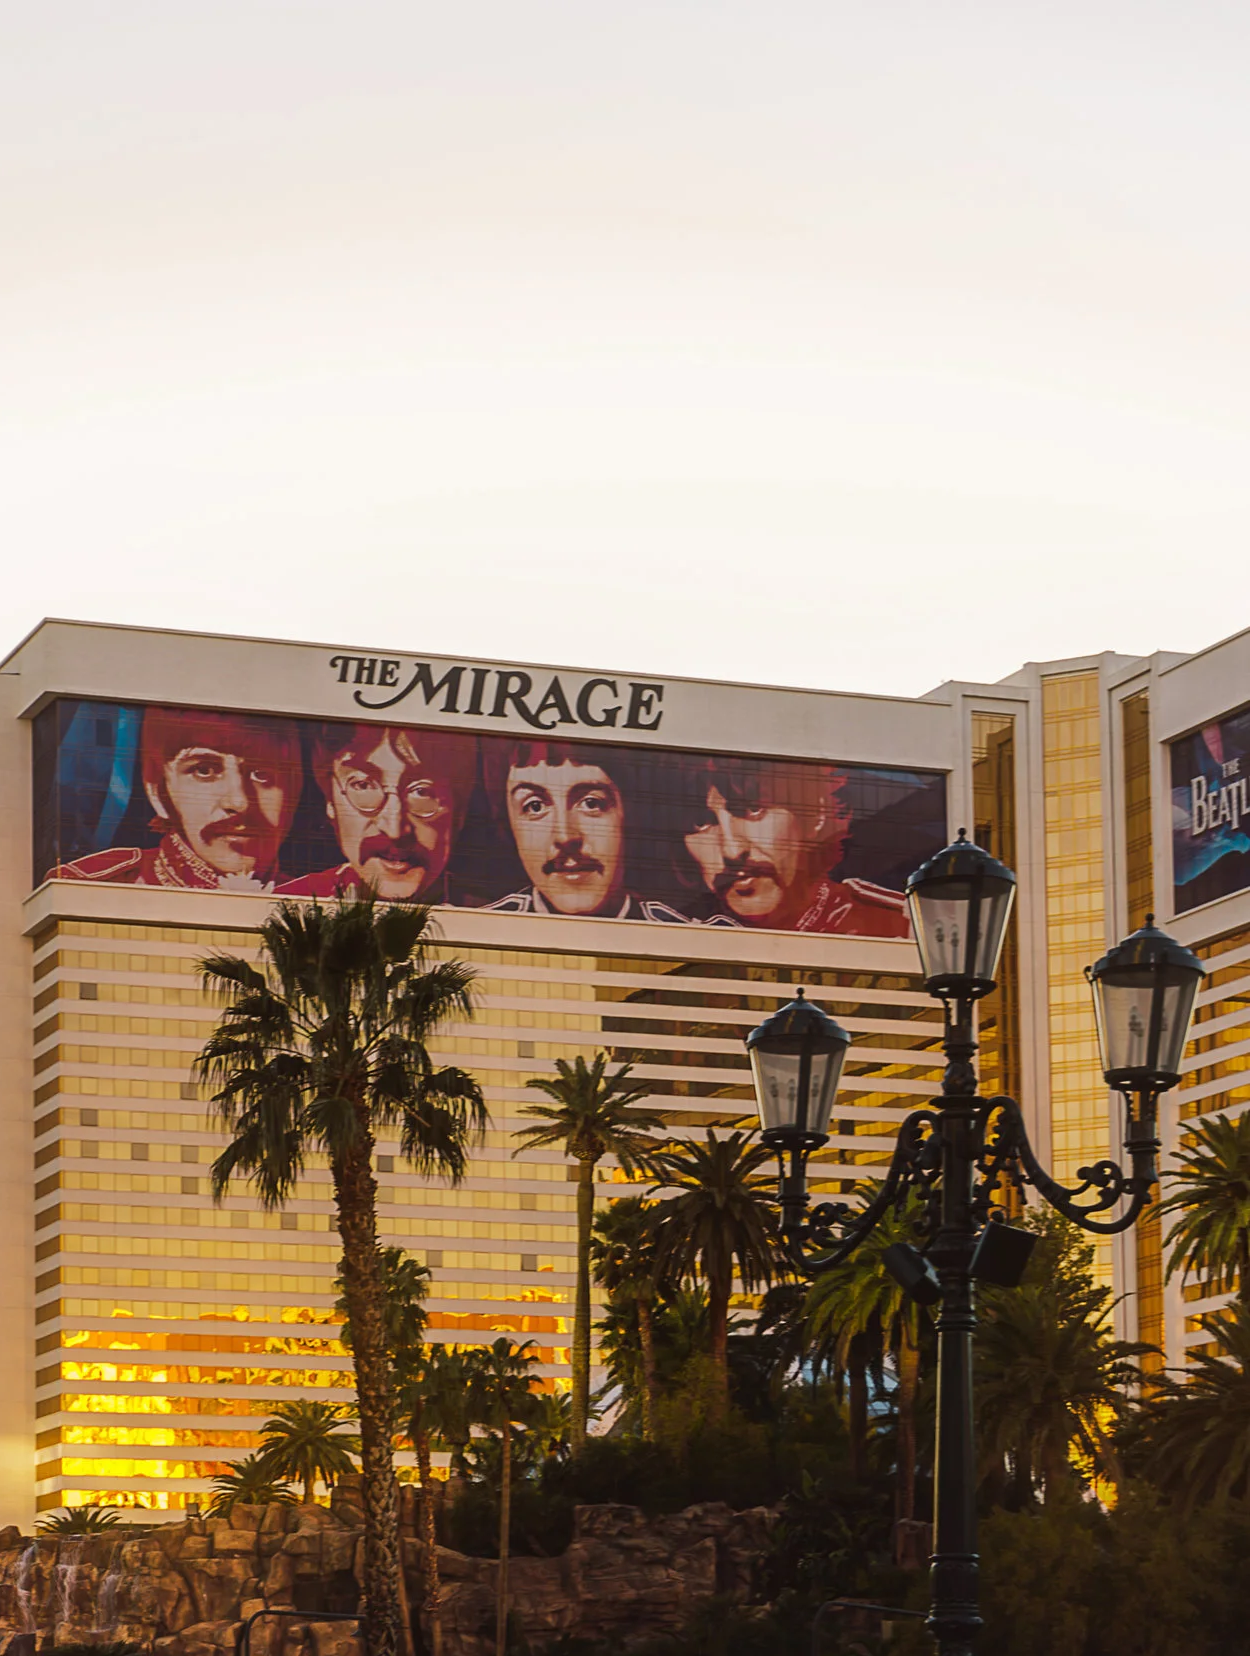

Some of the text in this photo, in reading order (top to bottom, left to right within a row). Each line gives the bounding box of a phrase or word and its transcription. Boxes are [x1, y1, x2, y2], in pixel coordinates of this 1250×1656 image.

[329, 655, 664, 730] THE MIRAGE
[1190, 775, 1250, 836] BEATL
